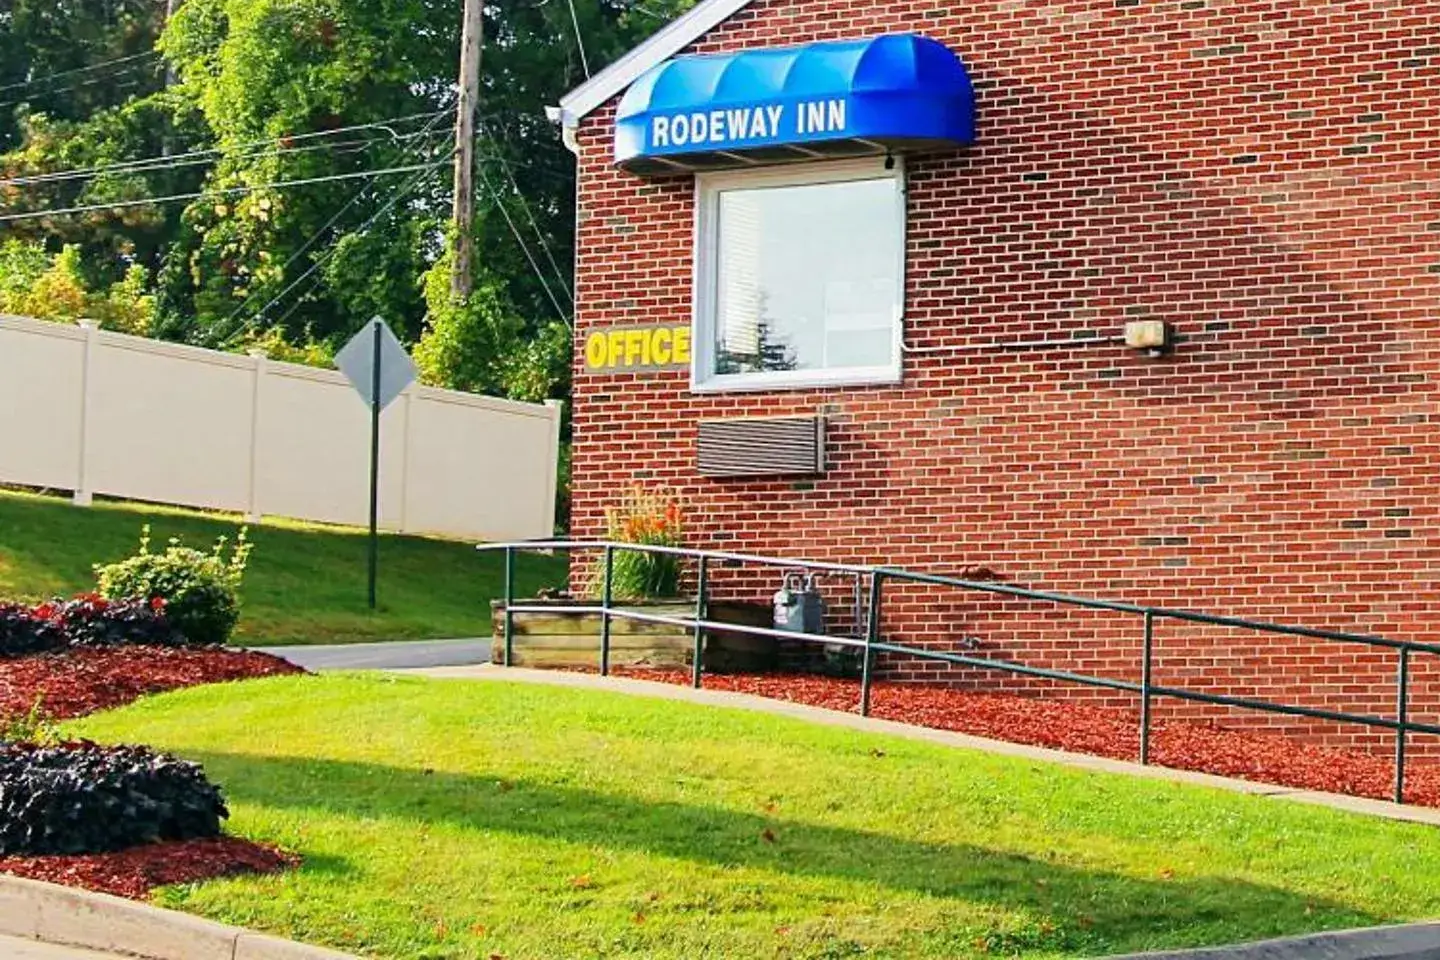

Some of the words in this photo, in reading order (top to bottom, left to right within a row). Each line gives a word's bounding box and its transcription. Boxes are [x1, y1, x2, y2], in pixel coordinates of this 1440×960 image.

[652, 105, 784, 147] RODEWAY
[797, 99, 846, 134] INN
[586, 326, 691, 369] OFFICE
